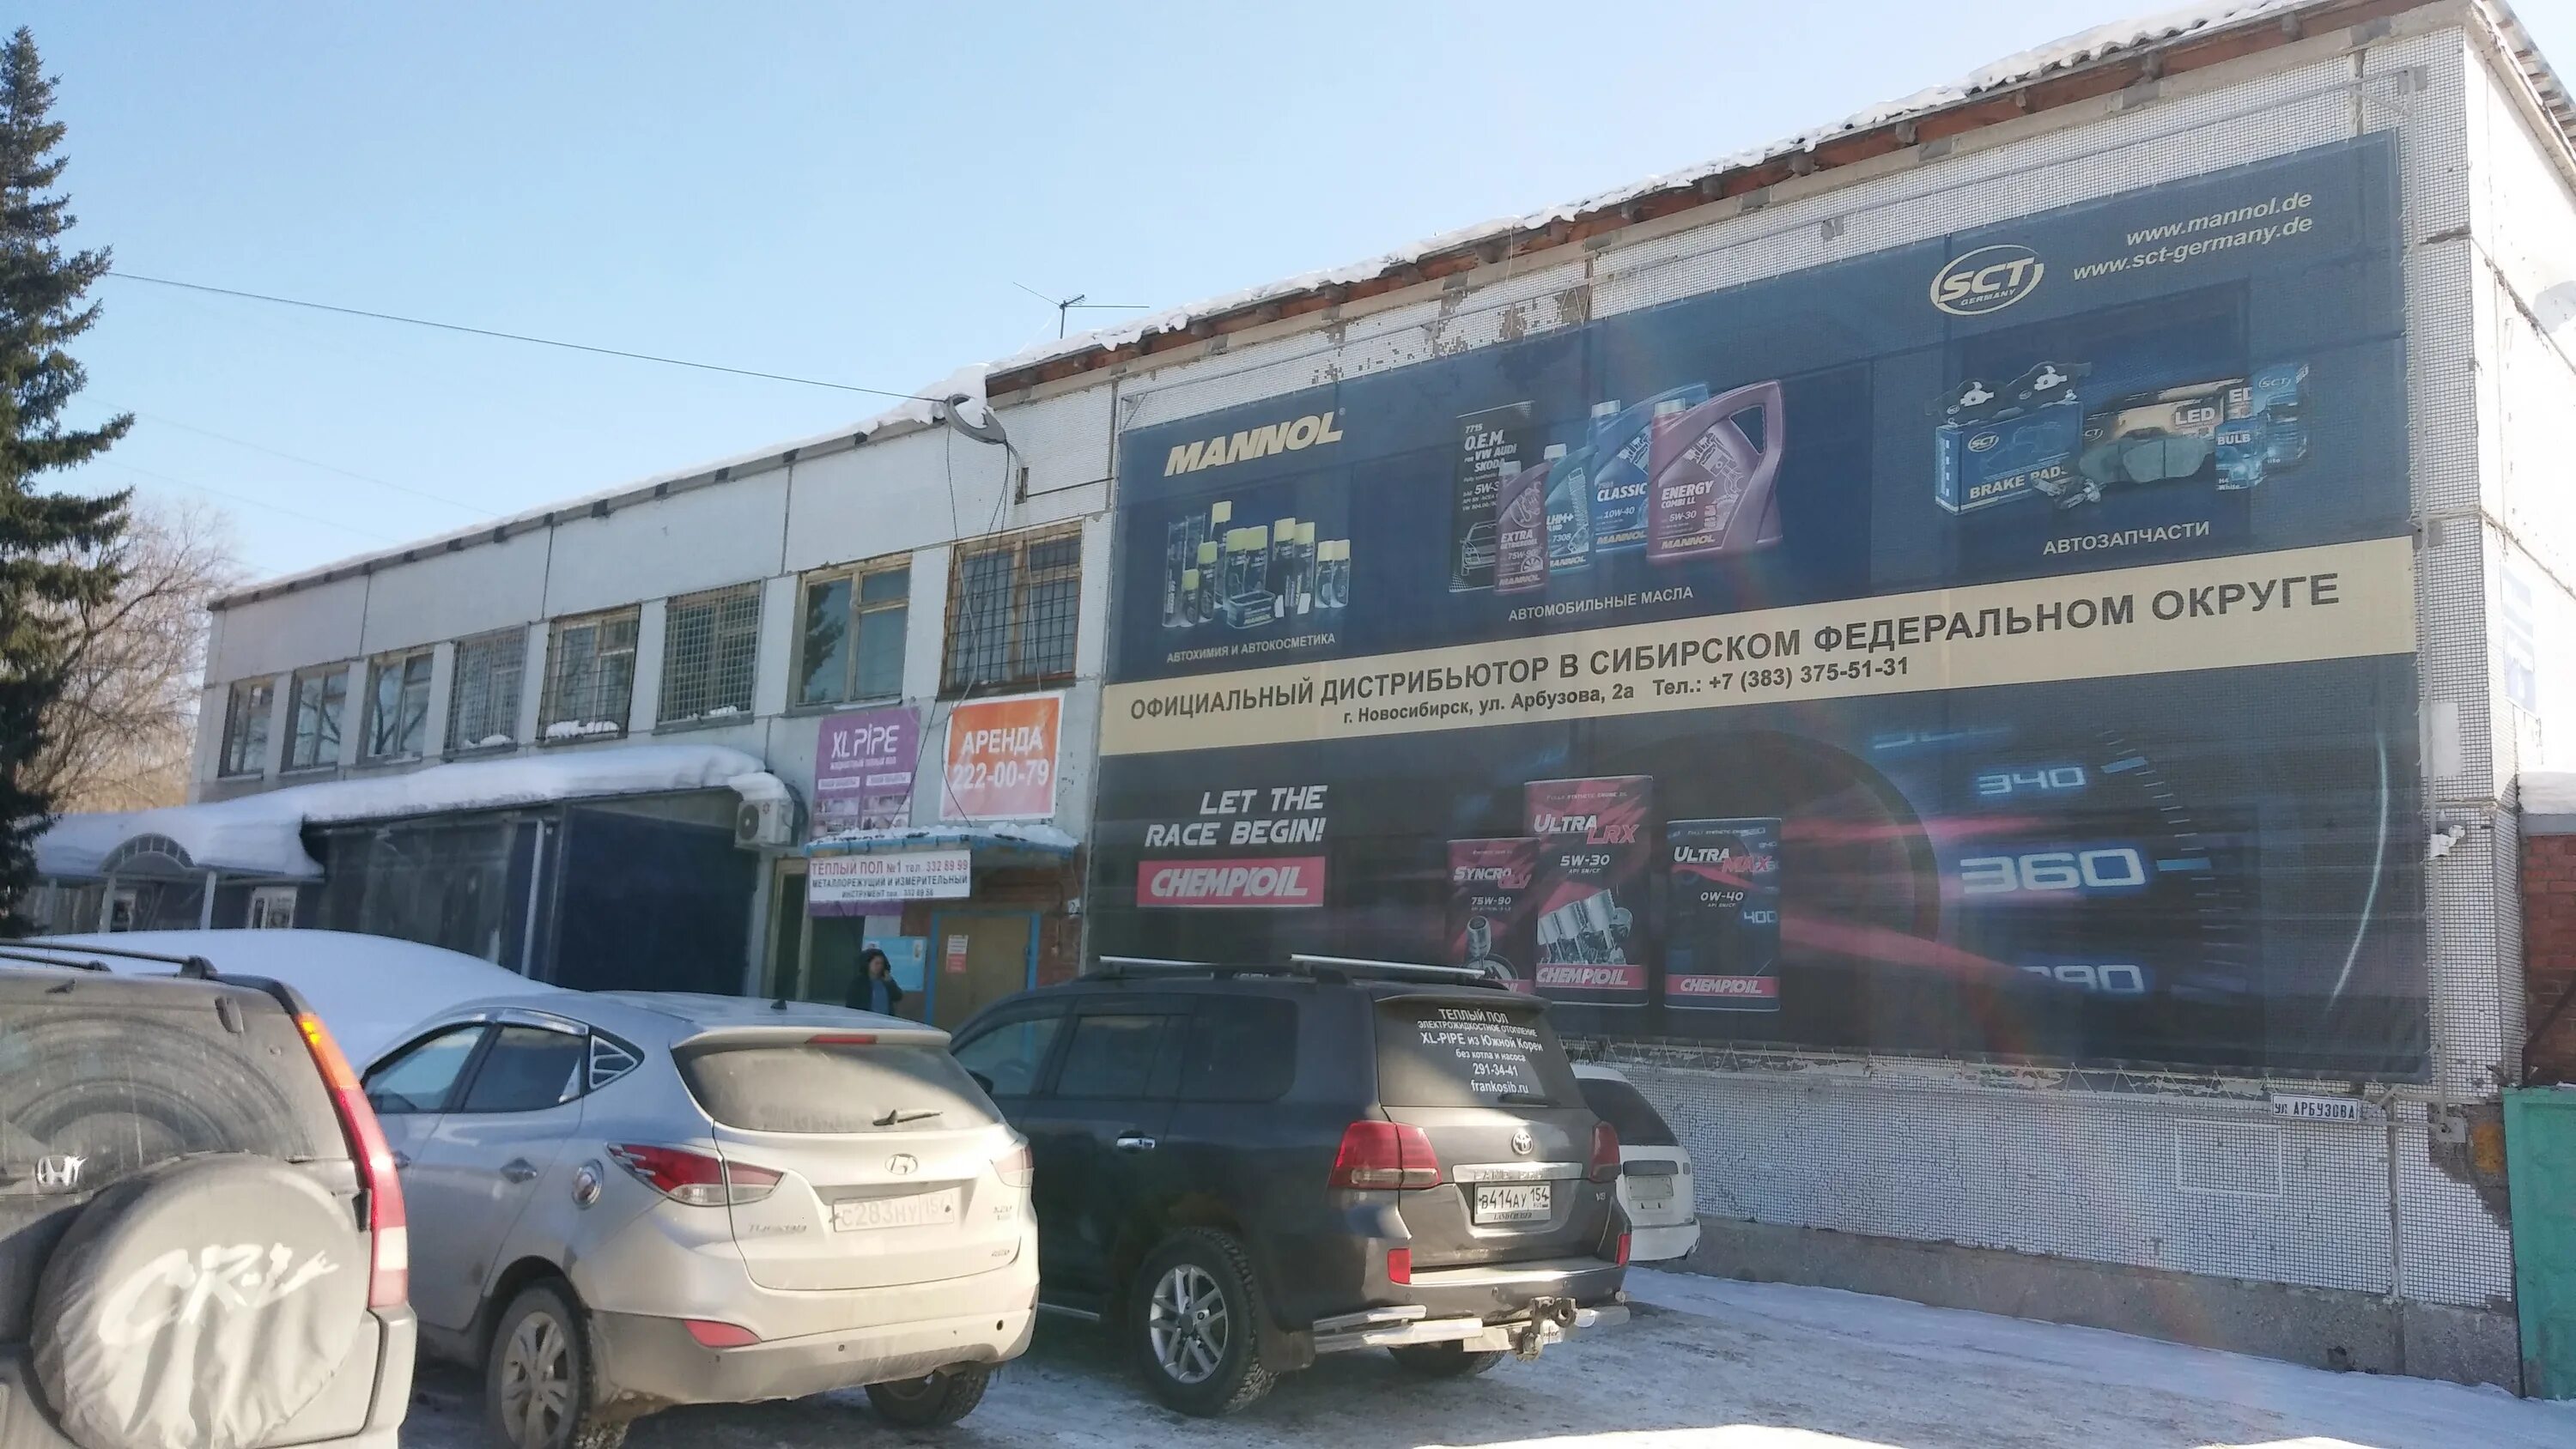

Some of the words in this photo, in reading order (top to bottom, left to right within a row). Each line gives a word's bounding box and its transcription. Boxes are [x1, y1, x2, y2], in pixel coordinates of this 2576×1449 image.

[2127, 191, 2312, 246] www.mannol.de
[2073, 215, 2313, 282] www.sct-germany.de
[1939, 257, 2035, 302] SCT
[1960, 288, 2016, 306] GERMANY
[2175, 407, 2215, 426] LED
[1163, 411, 1344, 476] MANNOL
[1463, 429, 1505, 452] O.E.M.
[1970, 433, 1997, 446] SCT
[2217, 432, 2251, 446] BULB
[1473, 448, 1493, 462] VW
[1493, 443, 1518, 458] AUDI
[1596, 482, 1648, 502] CLASSIC
[1661, 480, 1715, 500] ENERGY
[1969, 474, 2026, 500] BRAKE
[1603, 506, 1636, 519] 10W-40
[1661, 497, 1686, 509] COMBI
[1668, 509, 1698, 523] 5W-30
[1500, 528, 1534, 543] EXTRA
[1596, 529, 1648, 546] MANNOL
[1661, 534, 1716, 550] MANNOL
[2042, 521, 2210, 557] АВТОЗАПЧАСТИ
[1498, 573, 1541, 586] MANNOL
[1508, 591, 1637, 622] АВТОМОБИЛЬНЫЕ
[1640, 585, 1694, 607] МАСЛА
[1130, 676, 1314, 721] ОФИЦИАЛЬНЫЙ
[1320, 656, 1549, 707] ДИСТРИБЬЮТОР
[1559, 653, 1580, 678] В
[1589, 628, 1801, 676] СИБИРСКОМ
[1814, 593, 2135, 653] ФЕДЕРАЛЬНОМ
[2151, 572, 2340, 621] ОКРУГЕ
[1166, 645, 1229, 664] АВТОХИМИЯ
[1230, 643, 1239, 656] И
[1242, 632, 1336, 654] АВТОКОСМЕТИКА
[1343, 713, 1354, 725] г.
[1358, 699, 1474, 724] Новосибирск,
[1479, 697, 1507, 718] ул.
[1510, 686, 1607, 712] Арбузова,
[1613, 682, 1635, 702] 2а
[1653, 676, 1701, 697] Тел.:
[1708, 671, 1733, 692] +7
[1740, 667, 1793, 693] (383)
[1800, 656, 1909, 683] 375-51-31
[830, 731, 851, 759] XL
[961, 726, 1044, 755] АРЕНДА
[953, 759, 1049, 791] 222-00-79
[1978, 766, 2087, 796] 340
[1199, 788, 1258, 815] LET
[1270, 785, 1328, 812] THE
[1144, 822, 1221, 847] RACE
[1229, 816, 1327, 846] BEGIN!
[1534, 814, 1597, 833] ULTRA
[1586, 823, 1640, 845] LRX
[1559, 854, 1611, 867] 5W-30
[1674, 846, 1730, 863] ULTRA
[860, 860, 884, 874] ПОЛ
[1959, 848, 2146, 895] 360
[887, 877, 893, 887] И
[895, 873, 968, 887] ИЗМЕРИТЕЛЬНЫЙ
[1151, 865, 1309, 898] CHEMPIOIL
[1471, 896, 1512, 906] 75W-90
[1699, 891, 1745, 902] 0W-40
[1743, 910, 1777, 924] 400
[1536, 967, 1629, 986] CHEMPIOIL
[1680, 978, 1763, 995] CHEMPIOIL
[1437, 1008, 1486, 1022] ТЕПЛЫЙ
[1486, 1011, 1510, 1024] ПОЛ
[1417, 1021, 1501, 1032] ЭЛЕКТРОЖИДКОСТНОЕ
[1501, 1025, 1538, 1038] ОТОПЛЕНИЕ
[1420, 1032, 1467, 1046] XL-PIPE
[1467, 1036, 1480, 1046] из
[1481, 1034, 1516, 1048] Южной
[1516, 1037, 1544, 1053] Кореи
[1455, 1048, 1471, 1058] без
[1472, 1051, 1494, 1060] котла
[1502, 1052, 1527, 1063] насоса
[1472, 1062, 1519, 1077] 291-34-41
[1470, 1079, 1529, 1094] frankosib.ru
[2293, 1101, 2354, 1119] АРБУЗОВА
[1530, 1187, 1548, 1203] 154
